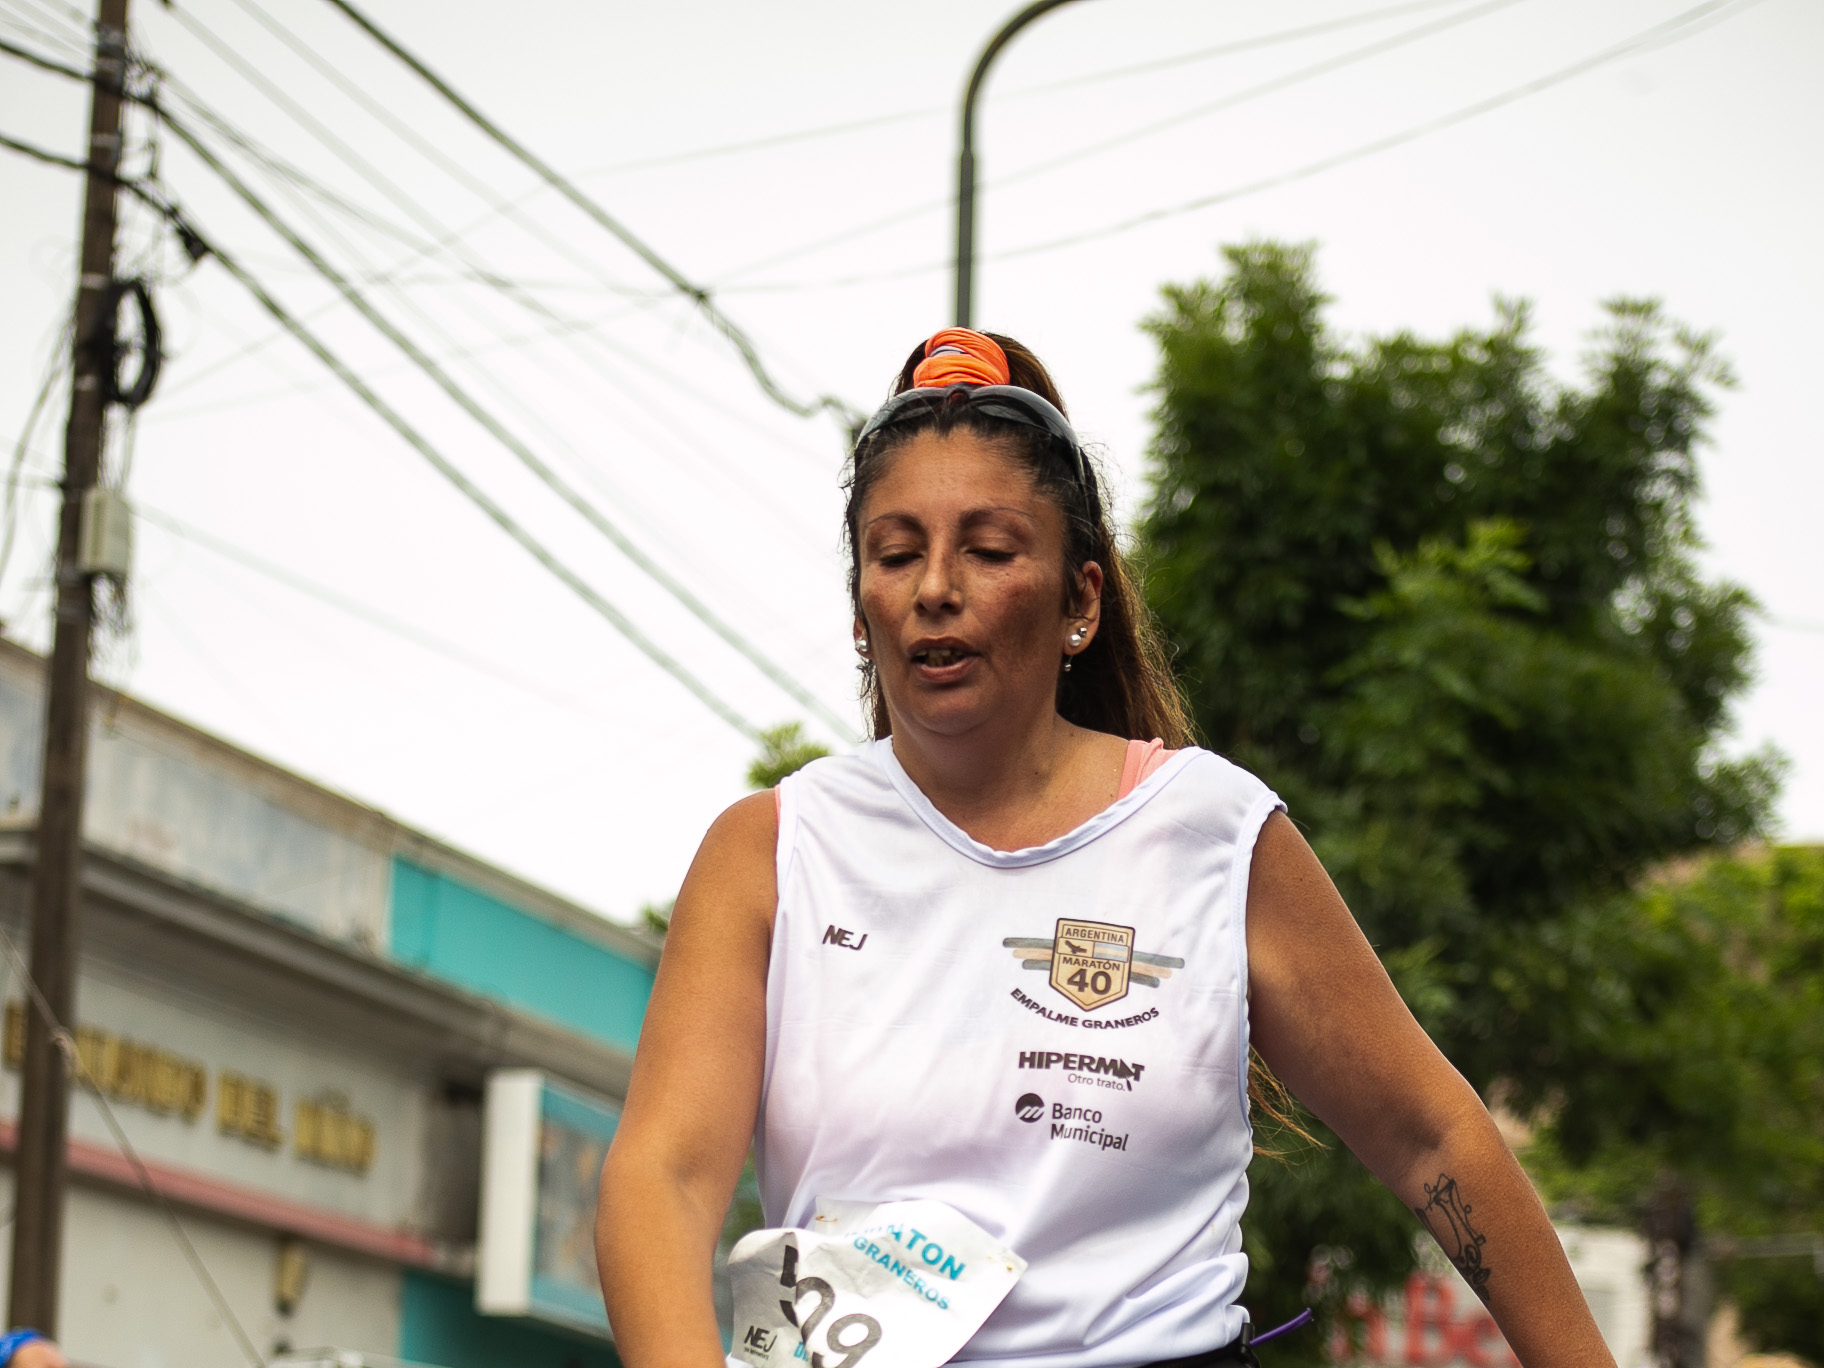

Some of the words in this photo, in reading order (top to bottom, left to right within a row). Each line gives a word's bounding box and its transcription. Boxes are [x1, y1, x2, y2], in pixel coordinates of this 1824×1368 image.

[822, 924, 868, 951] NEJ
[1065, 927, 1125, 944] ARGENTINA
[1062, 956, 1121, 972] MARATÓN
[1066, 968, 1112, 996] 40
[1010, 987, 1079, 1027] EMPALME
[1081, 1007, 1160, 1030] GRANEROS
[1067, 1073, 1094, 1085] Otro
[1096, 1077, 1126, 1092] trato.
[1052, 1102, 1103, 1124] Banco
[1050, 1123, 1129, 1152] Municipal
[853, 1236, 950, 1310] GRANEROS
[743, 1325, 777, 1353] NEJ
